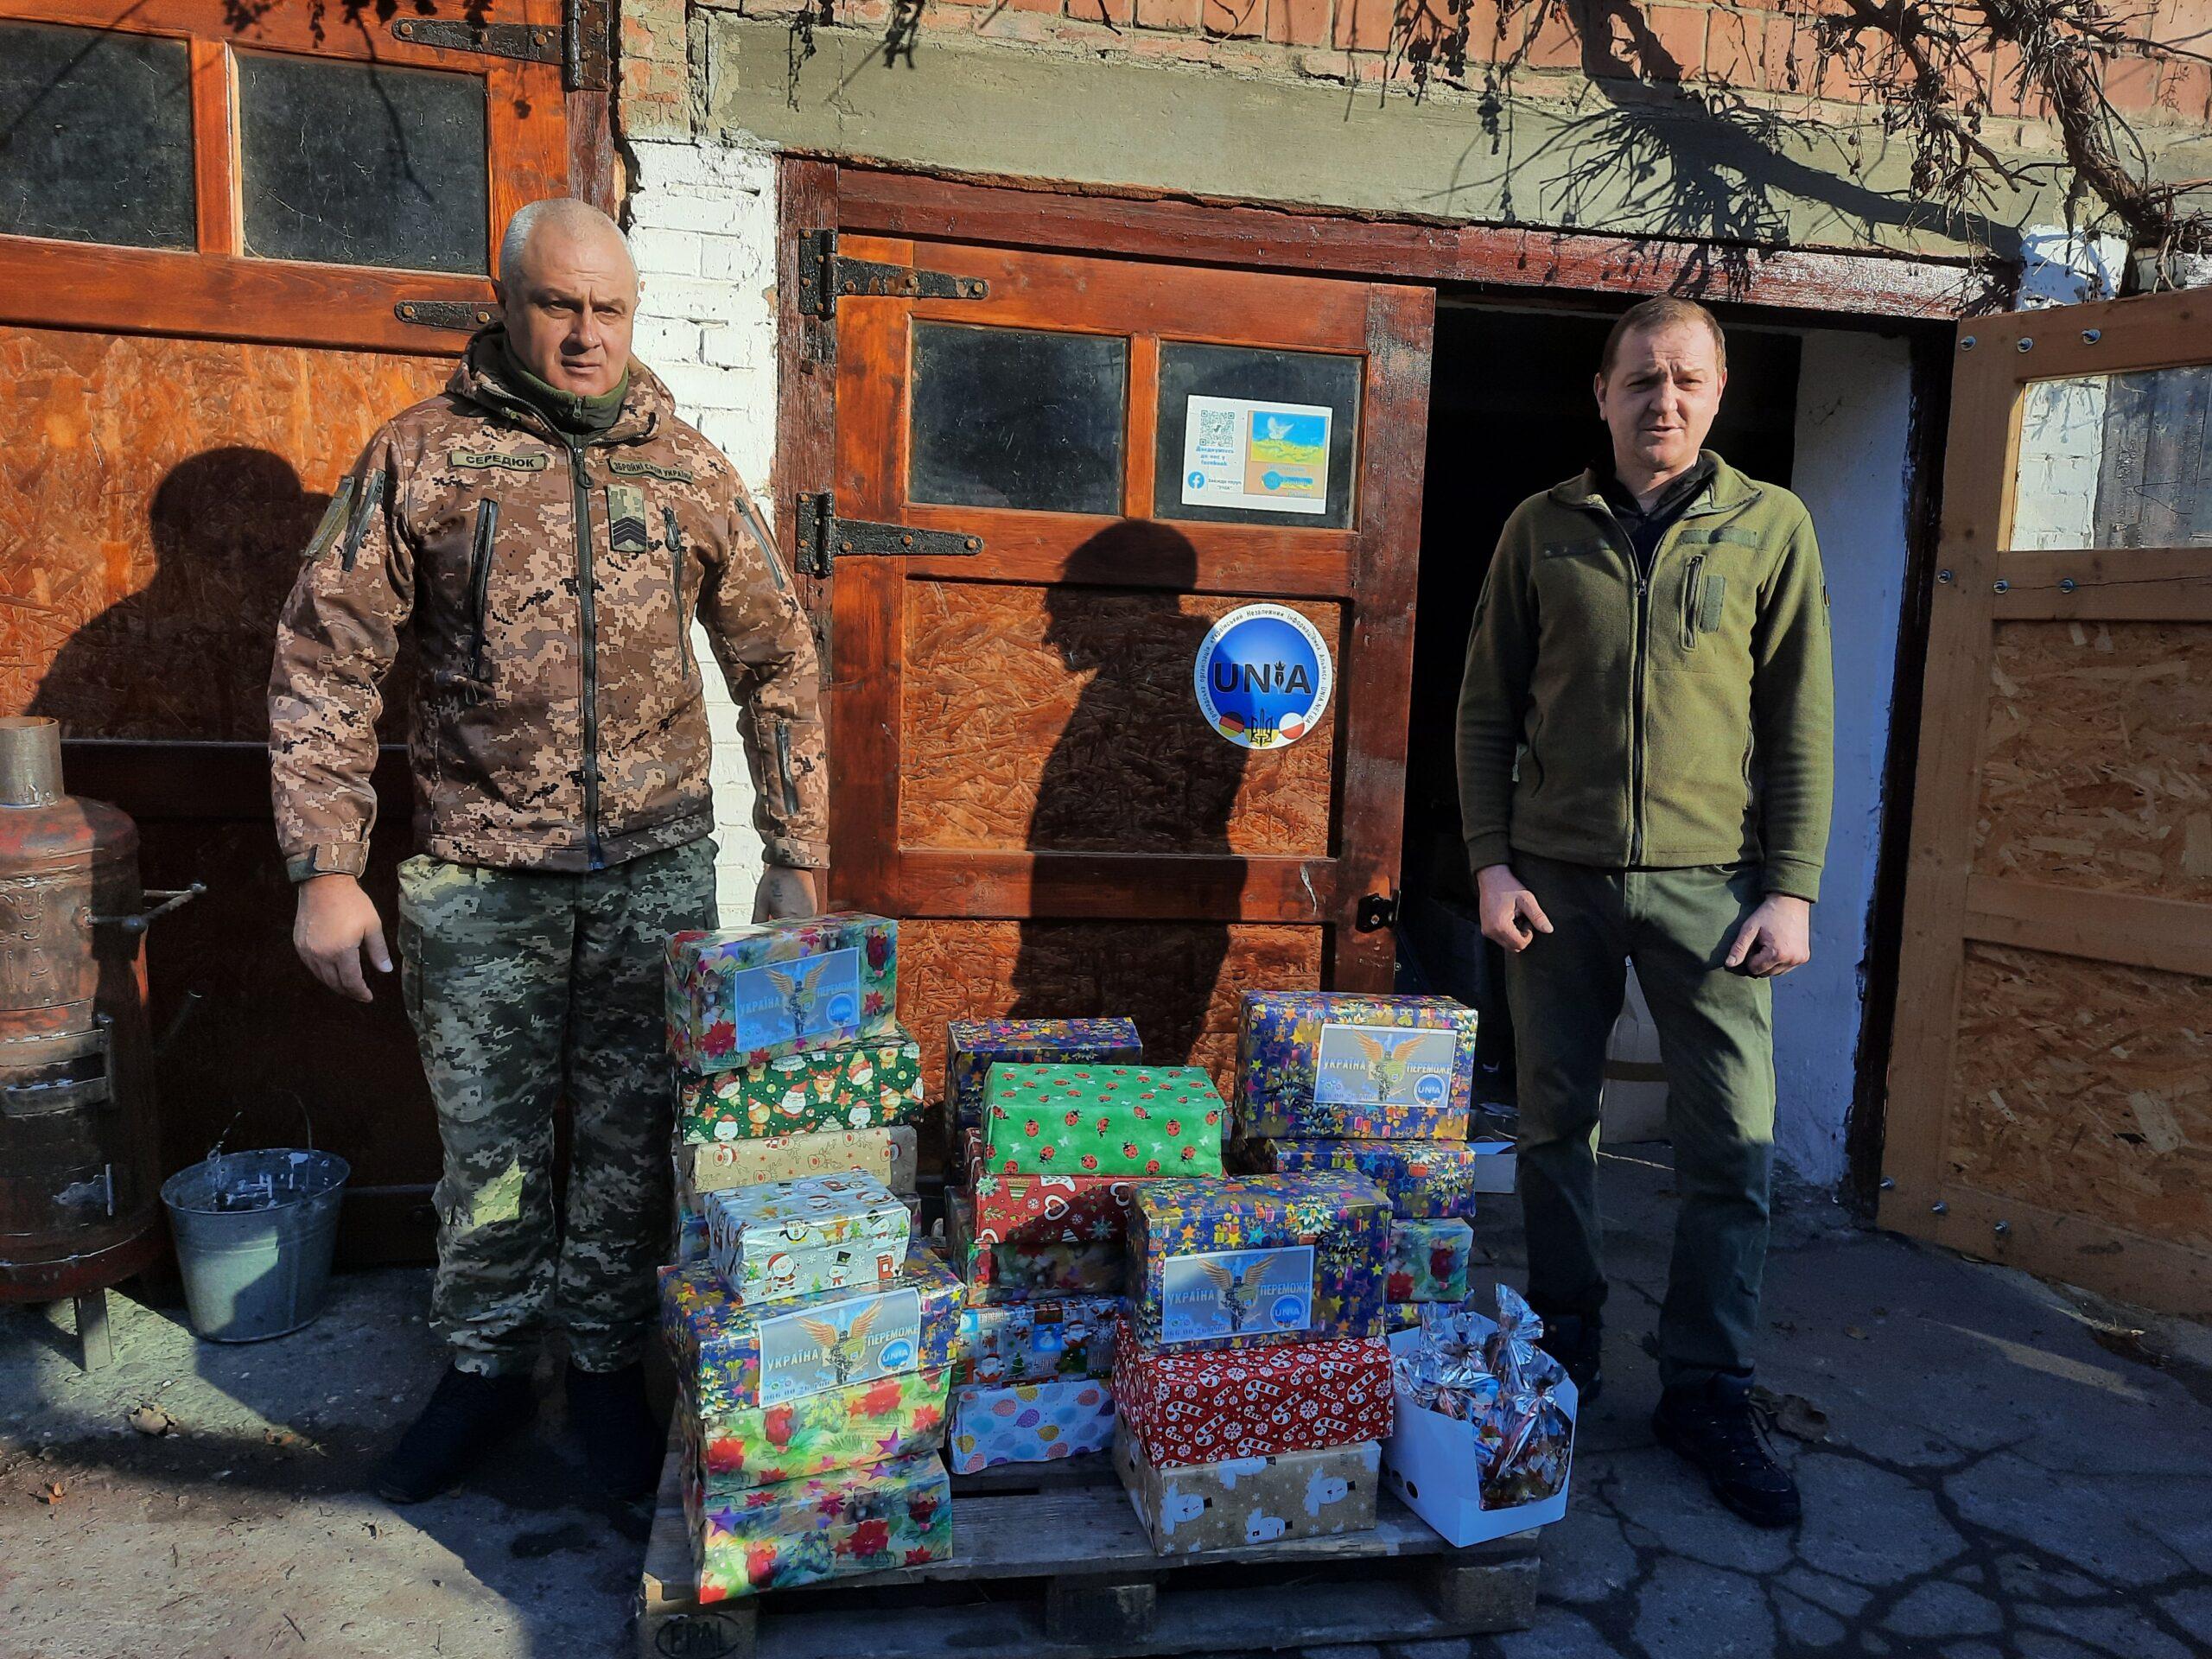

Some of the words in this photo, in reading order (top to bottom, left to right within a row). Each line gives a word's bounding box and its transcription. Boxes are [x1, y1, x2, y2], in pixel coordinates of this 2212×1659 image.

[466, 455, 535, 468] СЕРЕДЮК
[613, 462, 644, 472] ЗБРОЙНІ
[645, 464, 663, 475] СИЛИ
[663, 470, 692, 480] УКРАЇНИ
[1200, 646, 1211, 683] організація
[740, 996, 779, 1016] УКРАЇНА
[1324, 1058, 1366, 1071] УКРАЇНА
[1407, 1062, 1452, 1075] ПЕРЕМОЖЕ
[1418, 1085, 1441, 1095] UNIA
[1168, 1287, 1215, 1305] УКРАЇНА
[1260, 1282, 1310, 1296] ПЕРЕМОЖЕ
[766, 1348, 819, 1372] УКРАЇНА
[868, 1324, 919, 1348] ПЕРЕМОЖЕ
[881, 1348, 909, 1363] UNIA
